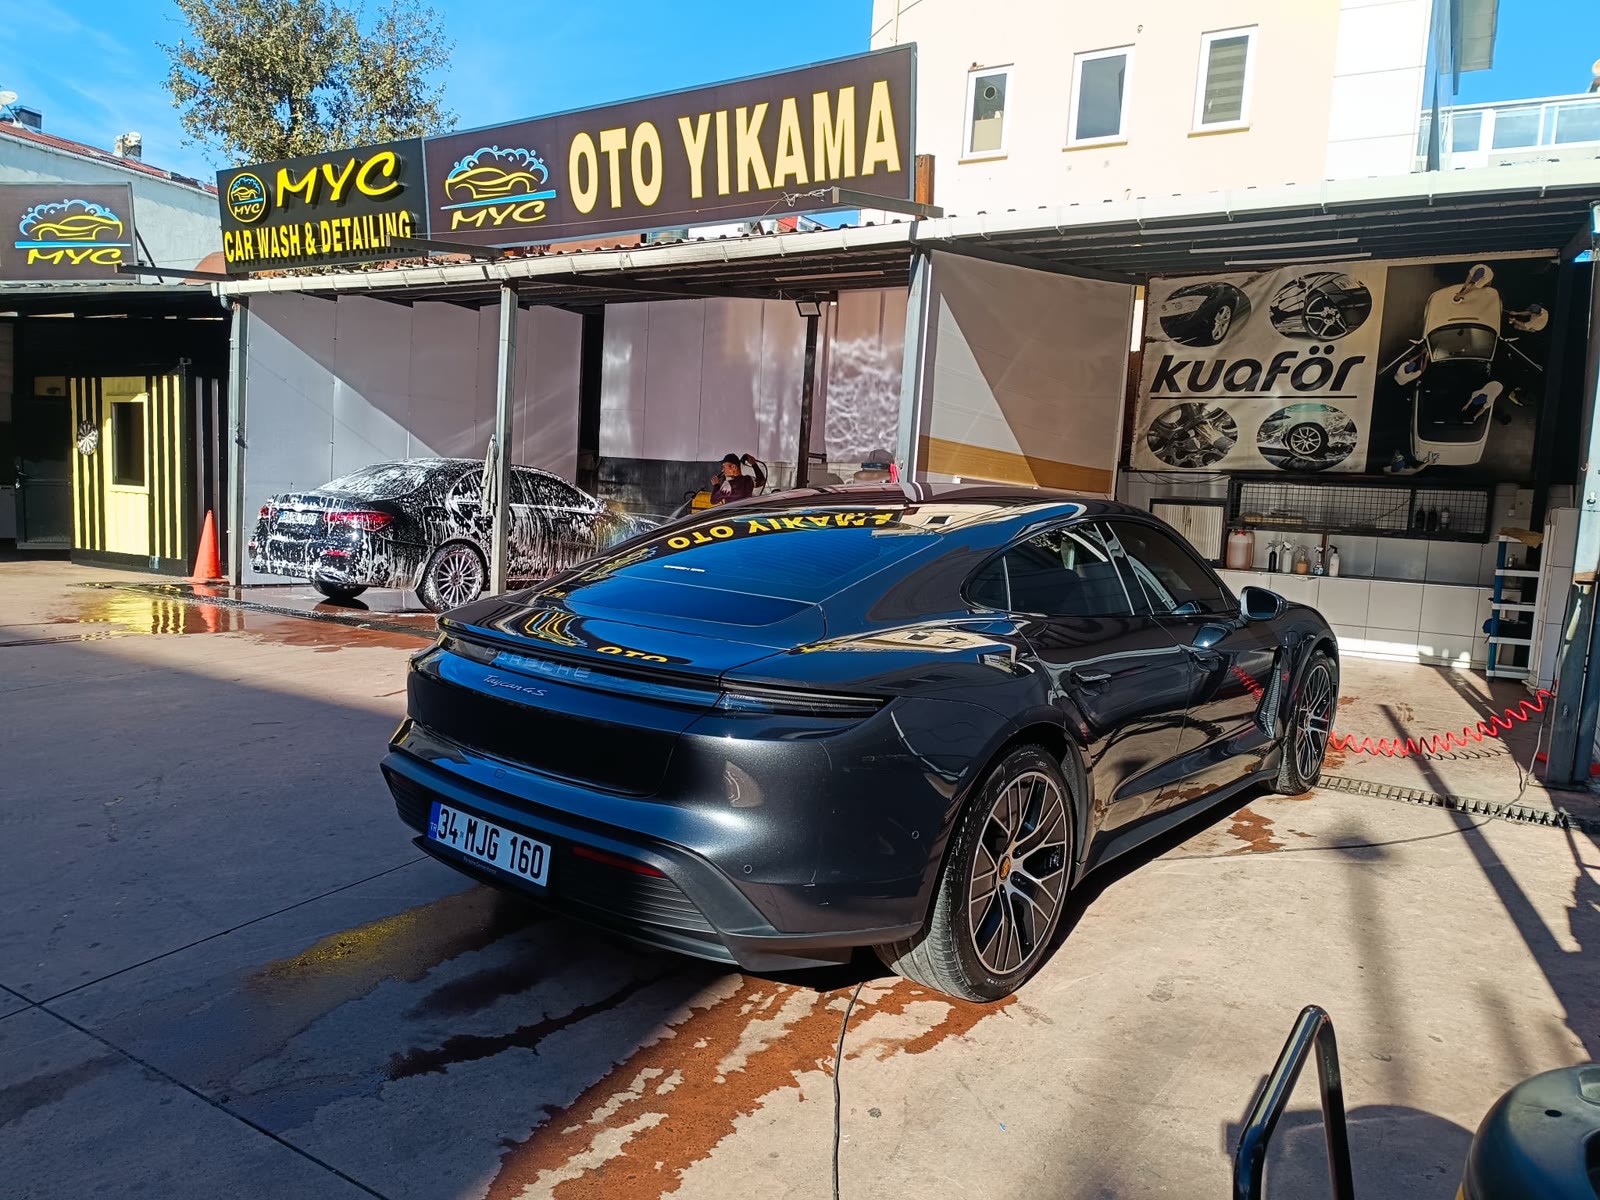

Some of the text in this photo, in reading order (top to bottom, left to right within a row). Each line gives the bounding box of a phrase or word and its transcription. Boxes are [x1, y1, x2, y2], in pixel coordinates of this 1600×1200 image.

[568, 80, 901, 214] OTO YIKAMA
[276, 152, 398, 207] MYC
[233, 203, 261, 216] MYC
[450, 199, 547, 230] MYC
[224, 209, 411, 263] CAR WASH & DETAILING
[26, 247, 123, 266] MYC
[1150, 344, 1366, 394] kuaför
[485, 647, 592, 679] PORSCHE
[483, 674, 521, 691] Taycan
[430, 821, 438, 833] TR
[438, 808, 458, 844] 34
[464, 818, 500, 861] MJG
[509, 836, 544, 880] 160
